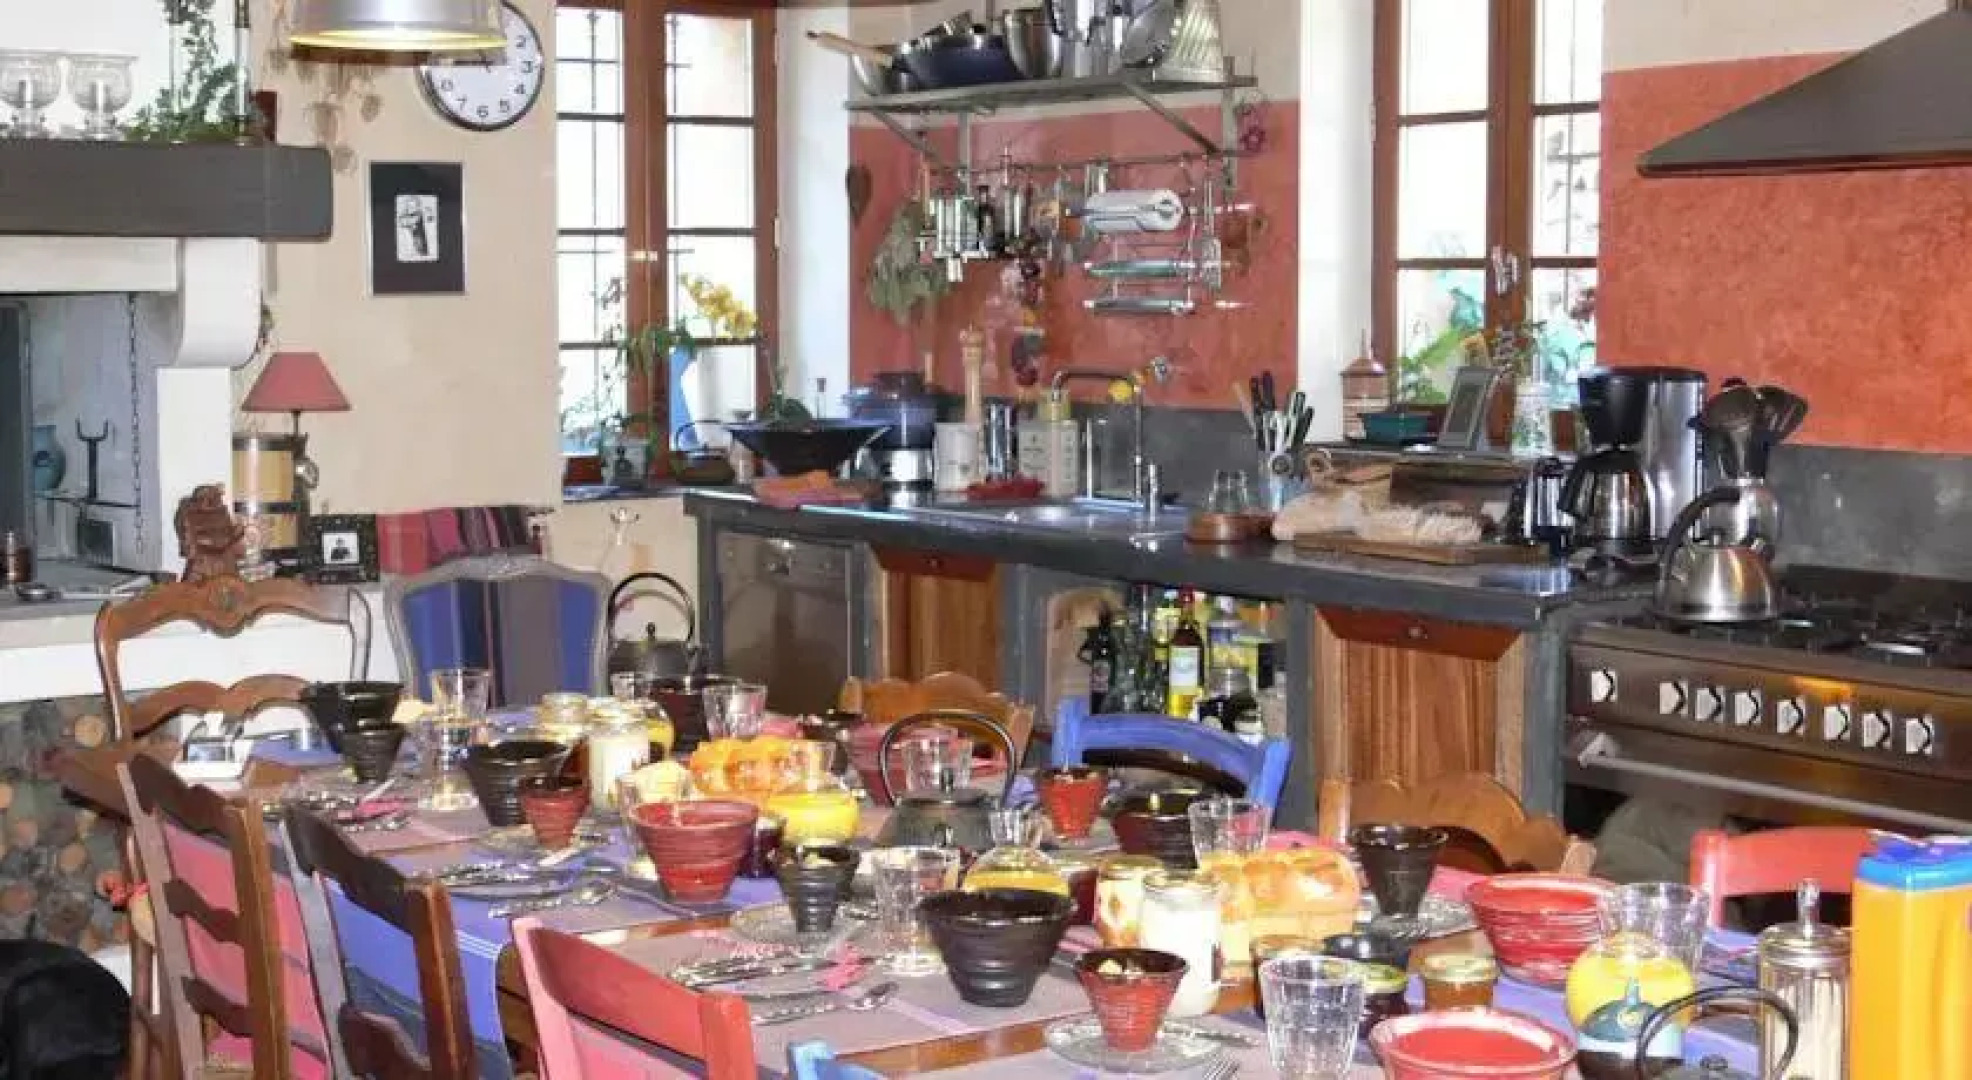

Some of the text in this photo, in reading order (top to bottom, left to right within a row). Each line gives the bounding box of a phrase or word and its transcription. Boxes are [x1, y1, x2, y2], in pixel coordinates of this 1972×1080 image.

[516, 35, 526, 48] 2
[521, 60, 533, 74] 3
[514, 84, 525, 95] 4
[477, 105, 489, 118] 6
[500, 99, 510, 113] 5
